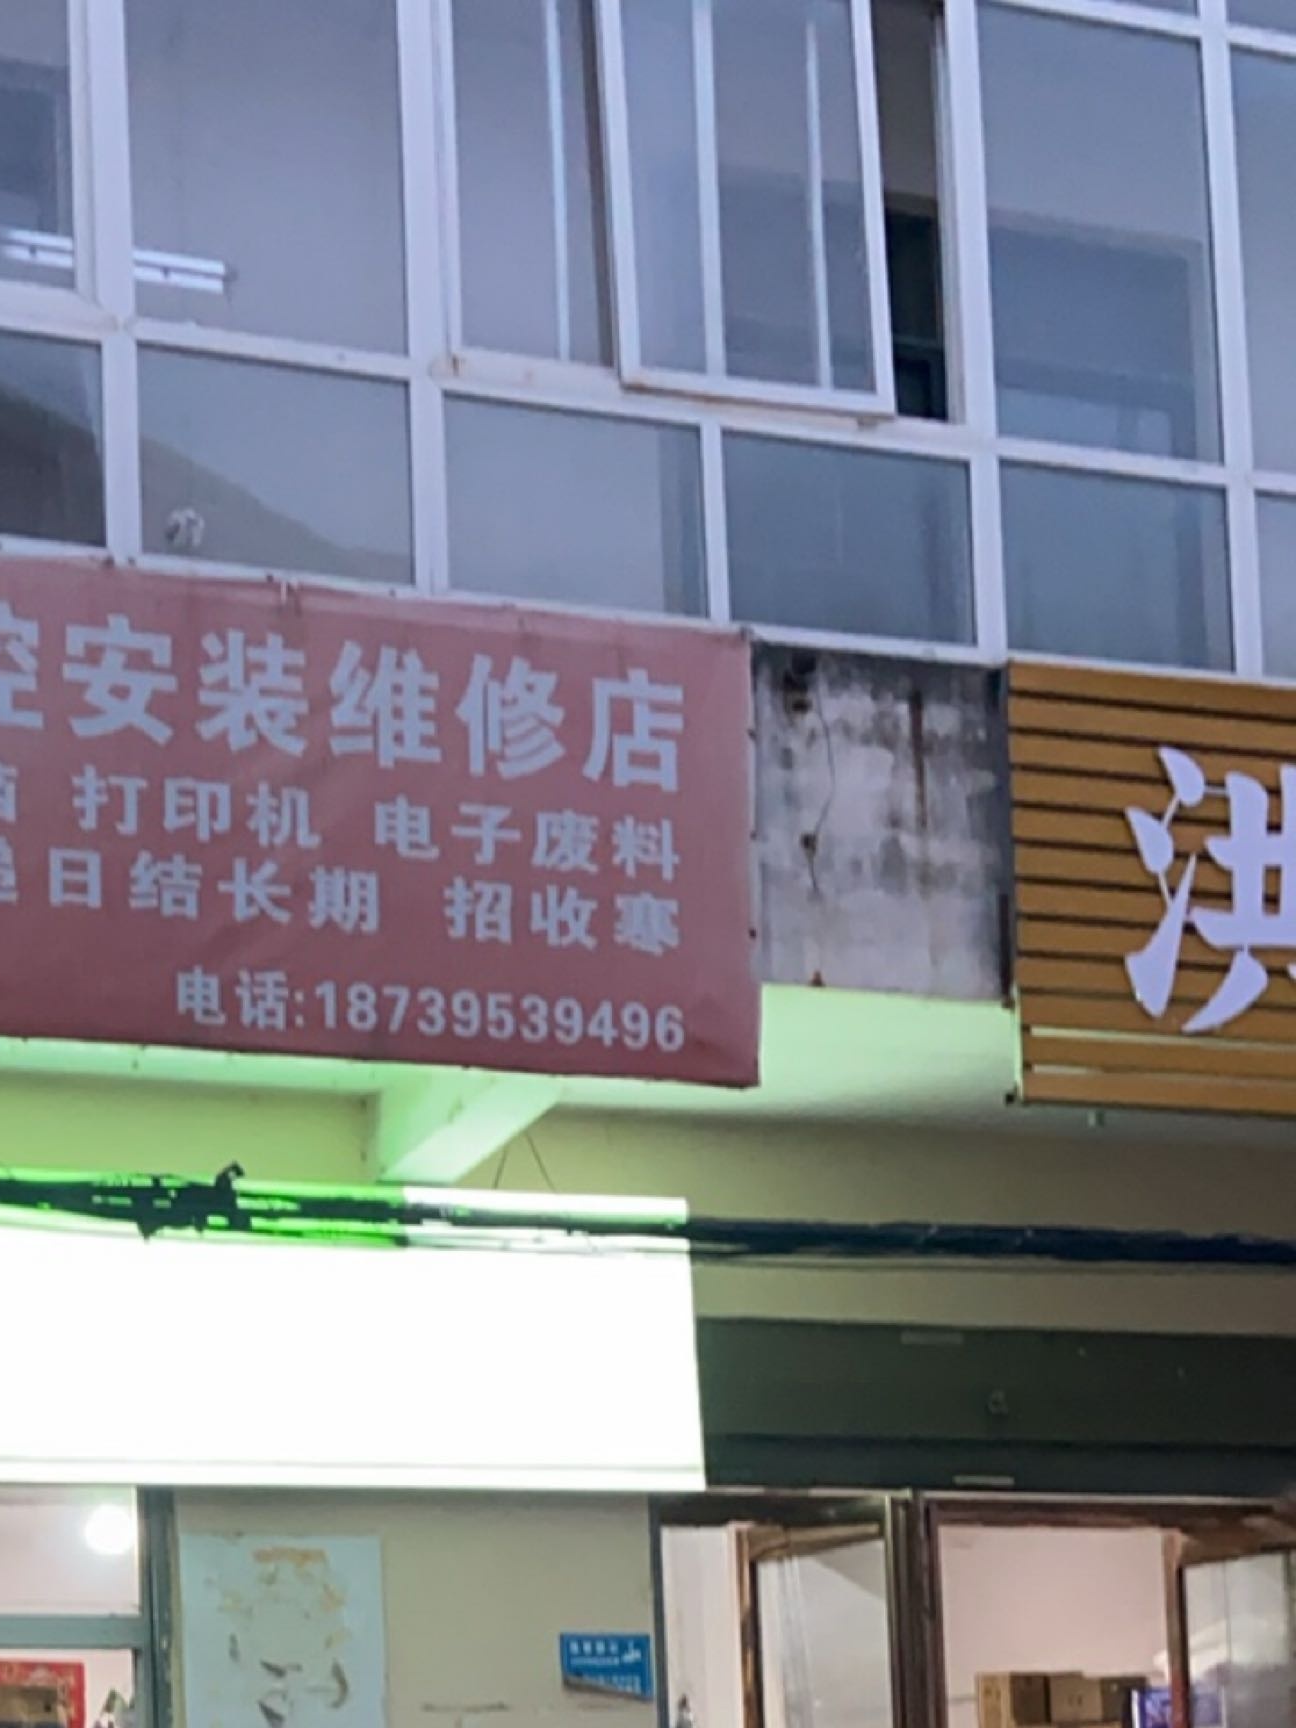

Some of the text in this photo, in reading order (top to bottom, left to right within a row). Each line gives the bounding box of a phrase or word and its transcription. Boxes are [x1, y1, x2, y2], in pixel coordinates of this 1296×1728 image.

[72, 764, 322, 851] 打印机
[373, 795, 680, 880] 电子废料
[443, 876, 681, 955] 招收寒
